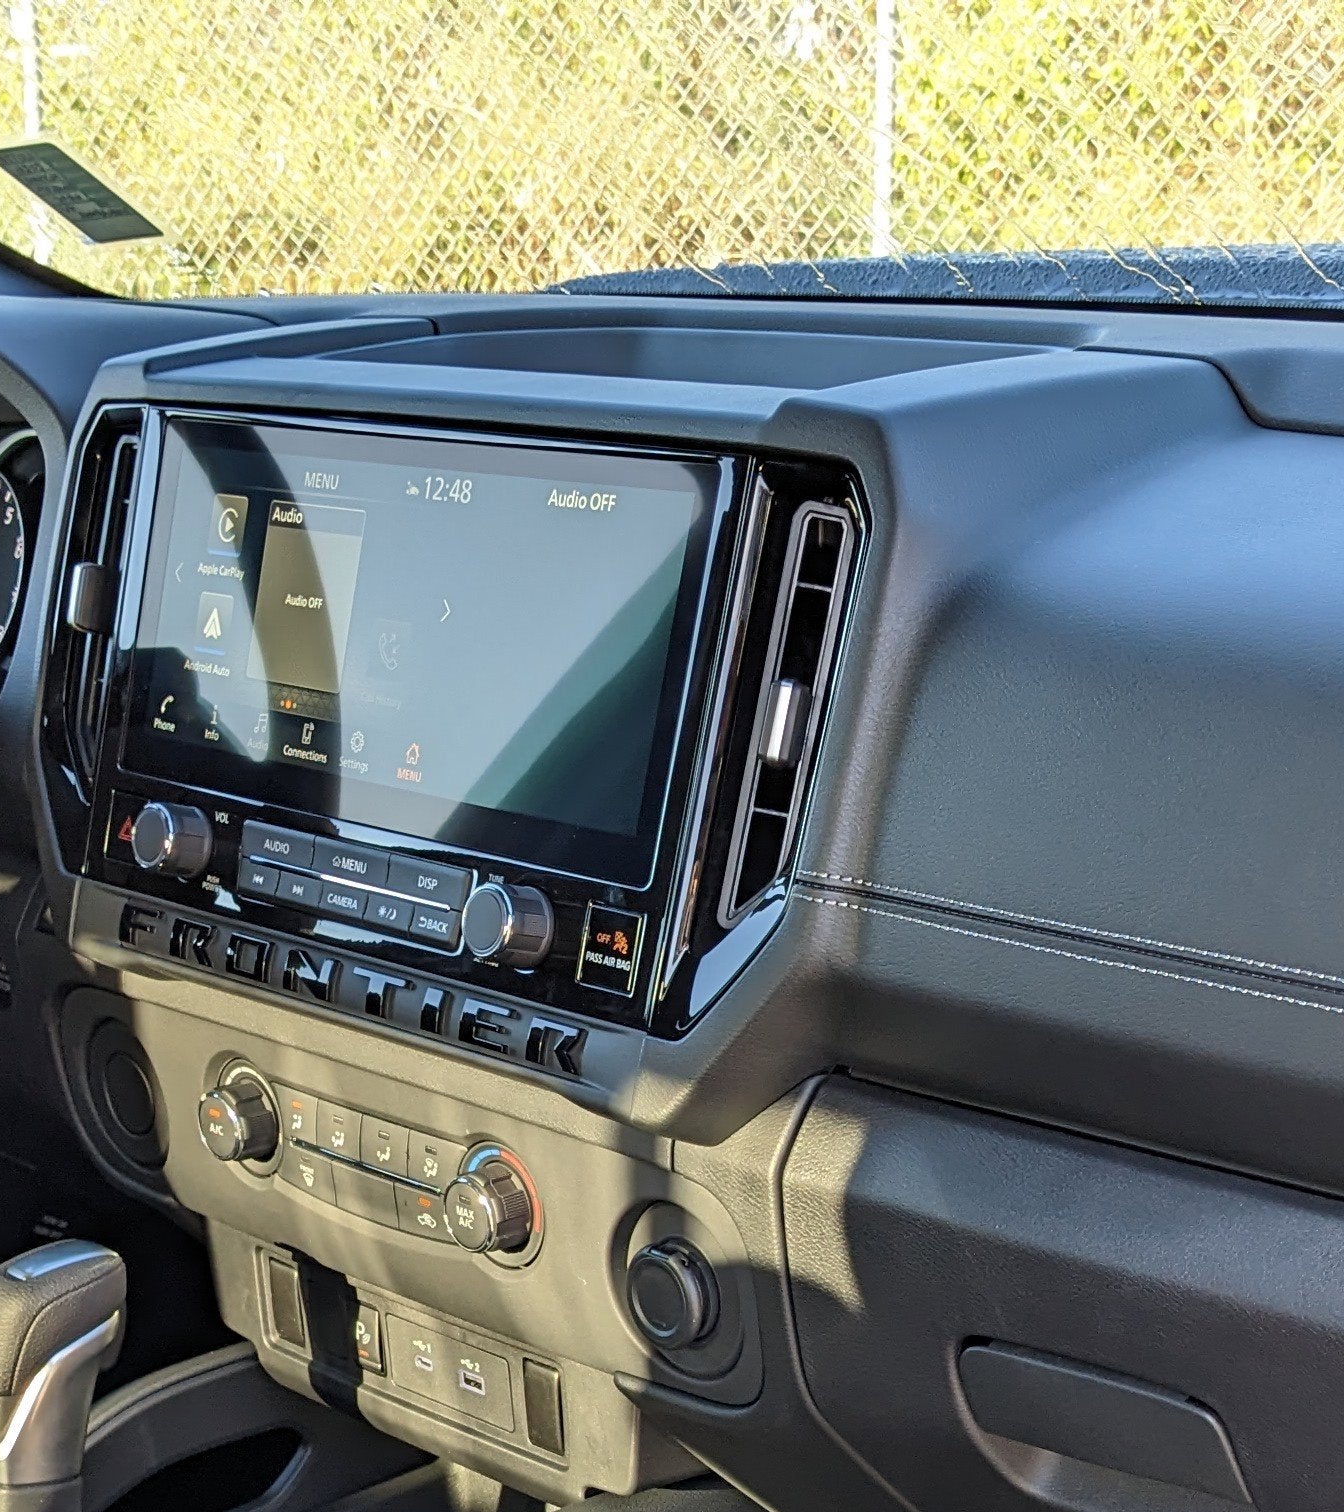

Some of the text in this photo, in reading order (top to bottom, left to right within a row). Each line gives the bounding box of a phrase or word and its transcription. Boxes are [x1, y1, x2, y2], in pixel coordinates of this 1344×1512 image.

[304, 472, 339, 490] MENU
[424, 476, 473, 504] 12:48
[548, 488, 617, 512] Audio OFF
[4, 506, 15, 525] 5
[271, 506, 304, 525] Audio
[197, 562, 245, 581] Apple CarPlay
[284, 592, 323, 610] Audio OFF
[183, 659, 231, 678] Android Auto
[153, 717, 176, 733] Phone
[204, 728, 220, 742] Info
[247, 738, 269, 752] Audio
[282, 744, 328, 764] Connections
[339, 756, 369, 775] Settings
[396, 768, 422, 783] MENU
[214, 810, 230, 825] VOL
[263, 838, 290, 855] AUDIO
[340, 856, 368, 875] MENU
[417, 875, 439, 891] DISP
[488, 873, 505, 884] TUNE
[327, 892, 358, 910] CAMERA
[428, 918, 449, 934] BACK
[596, 932, 612, 944] OFF
[585, 950, 631, 972] PASS AIR BAG
[118, 896, 590, 1077] FRONTIER
[209, 1122, 224, 1137] A/C
[456, 1204, 475, 1221] MAX
[457, 1216, 474, 1231] A/C
